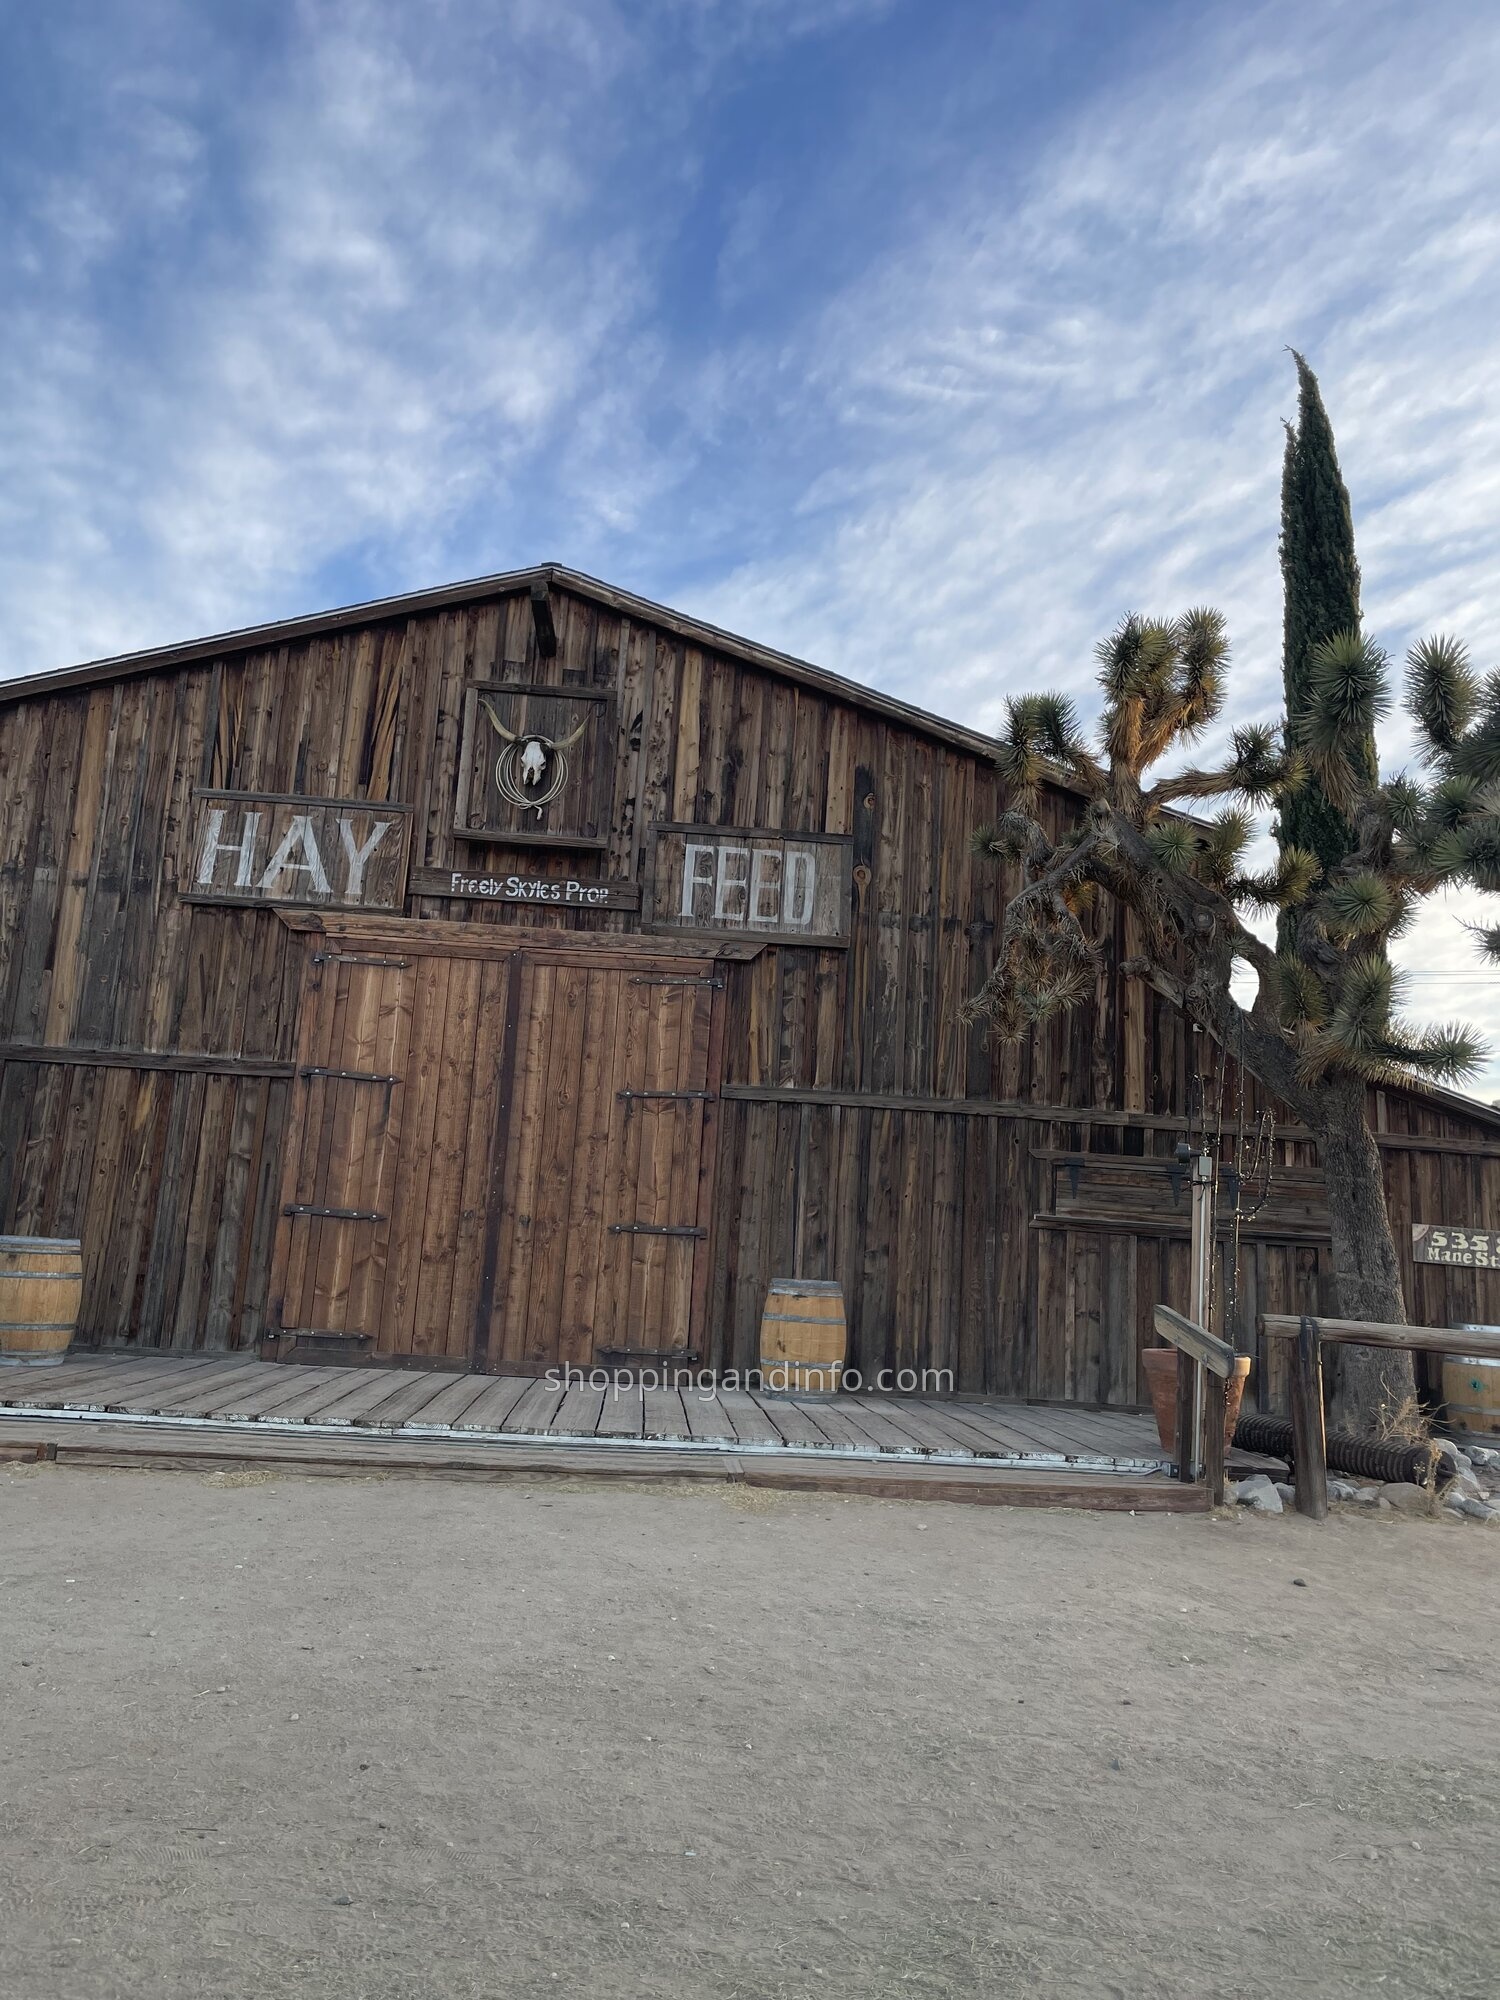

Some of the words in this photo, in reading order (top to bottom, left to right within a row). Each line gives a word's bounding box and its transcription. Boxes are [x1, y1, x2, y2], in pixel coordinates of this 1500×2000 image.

[197, 809, 393, 895] HAY
[451, 872, 503, 896] Freely
[505, 876, 560, 900] Skyles
[678, 844, 816, 925] FEED
[1427, 1247, 1473, 1264] Mane
[1431, 1231, 1500, 1253] 535
